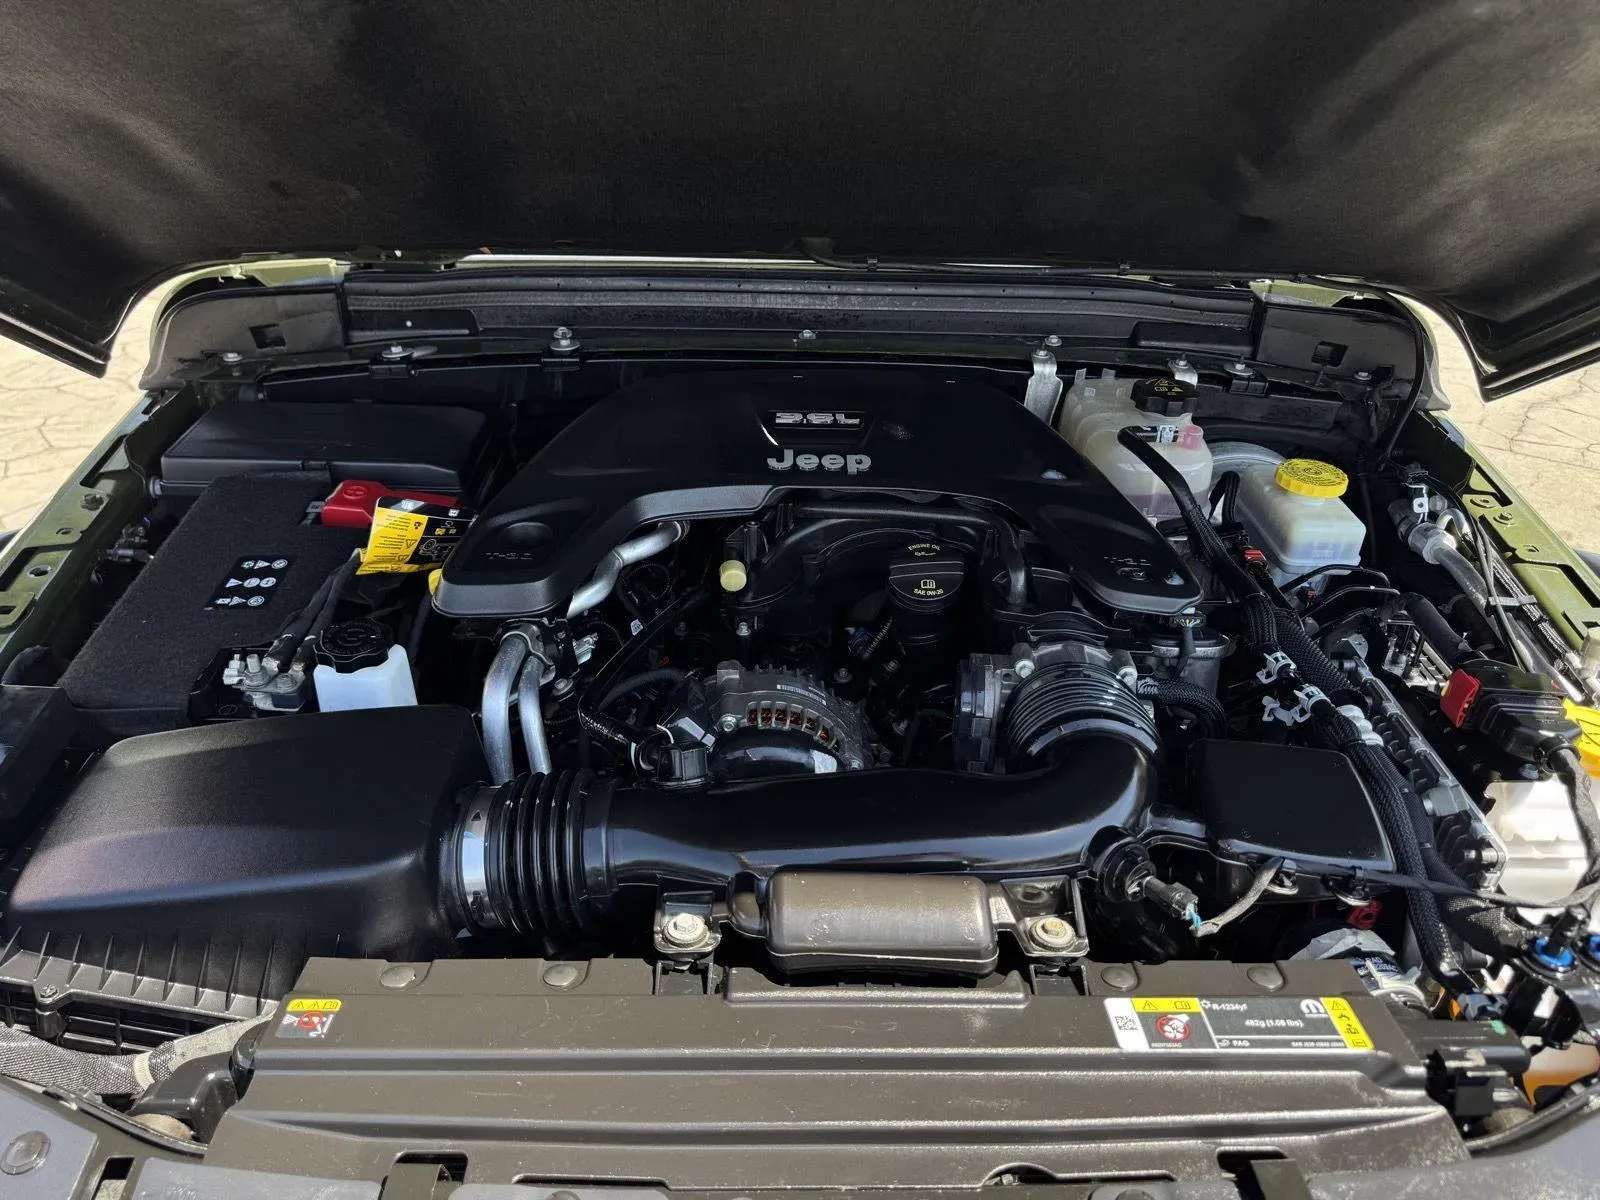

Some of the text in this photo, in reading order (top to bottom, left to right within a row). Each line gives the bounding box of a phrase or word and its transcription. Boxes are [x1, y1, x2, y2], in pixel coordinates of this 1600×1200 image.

[775, 412, 860, 425] 3.6L
[766, 448, 872, 475] Jeep
[907, 543, 941, 551] ENGINE OIL
[913, 588, 944, 596] SAE 0W-20
